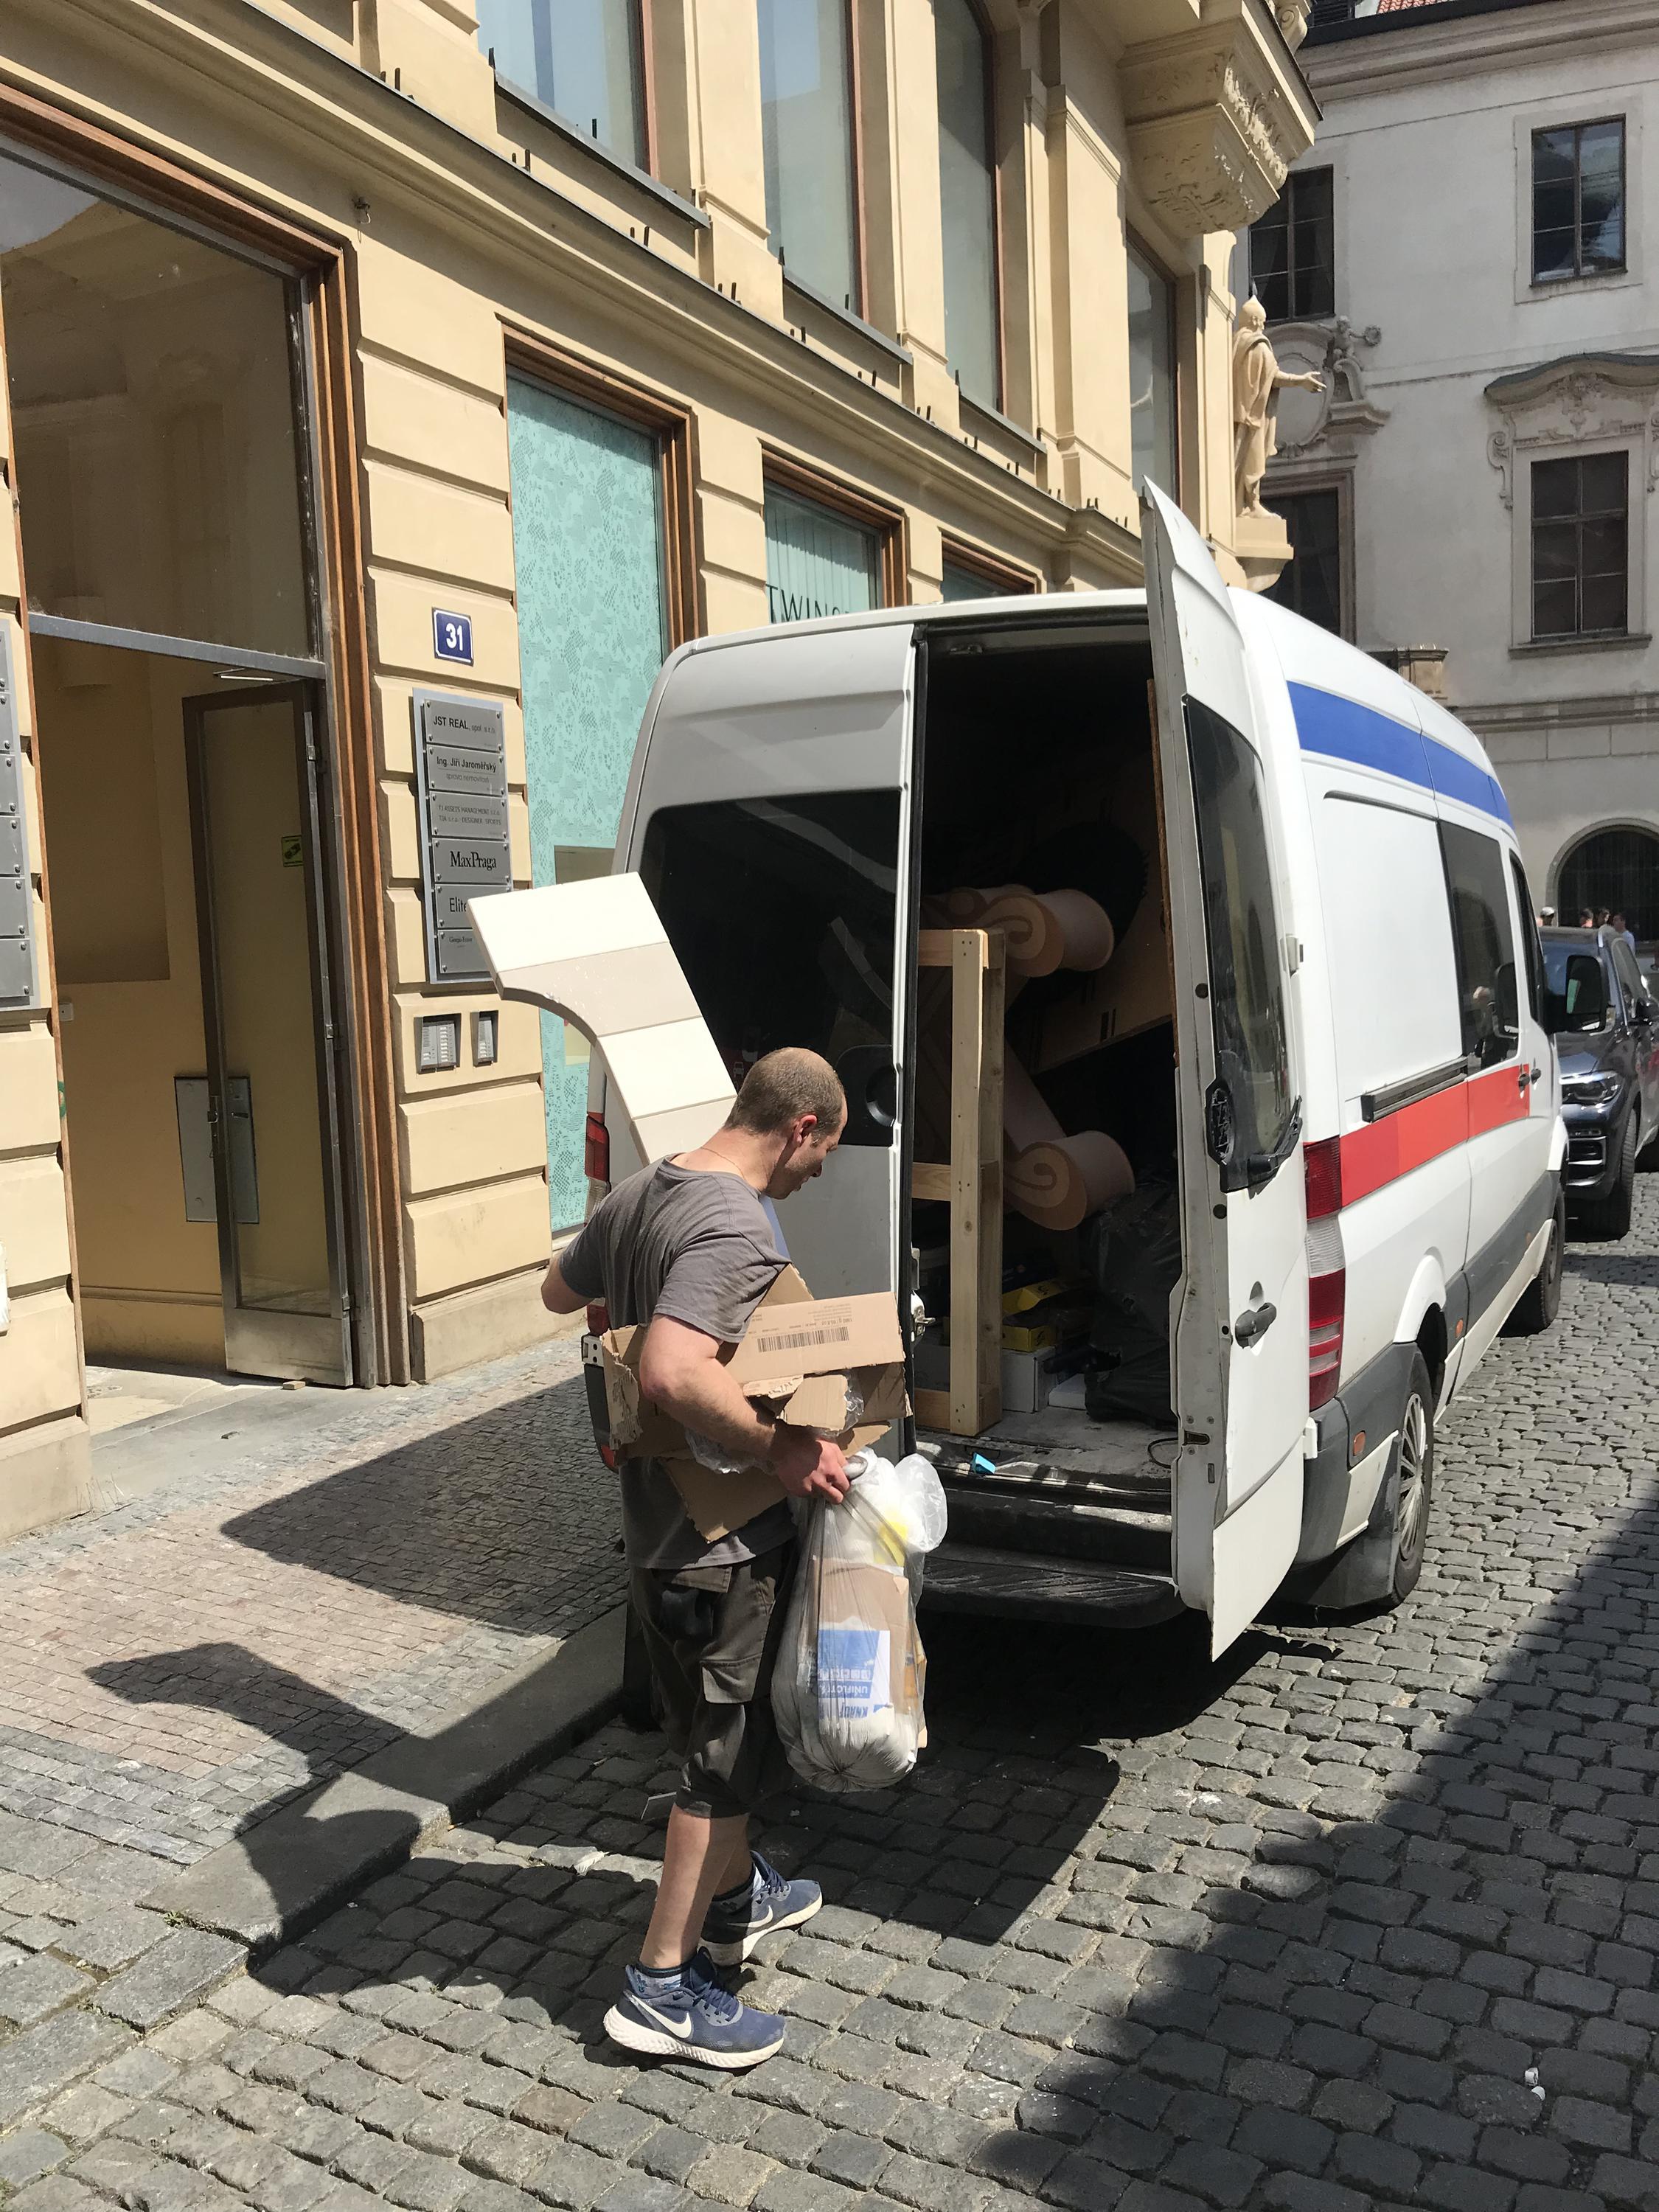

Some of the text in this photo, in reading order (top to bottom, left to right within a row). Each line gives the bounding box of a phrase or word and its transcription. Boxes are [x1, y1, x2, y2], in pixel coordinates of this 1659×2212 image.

[765, 583, 849, 625] TWIN
[445, 622, 463, 651] 31
[434, 715, 447, 726] JST
[437, 756, 496, 773] Ing. Jiří Jaroměřský
[450, 851, 497, 871] MaxPraga
[839, 1703, 869, 1718] KNAUF
